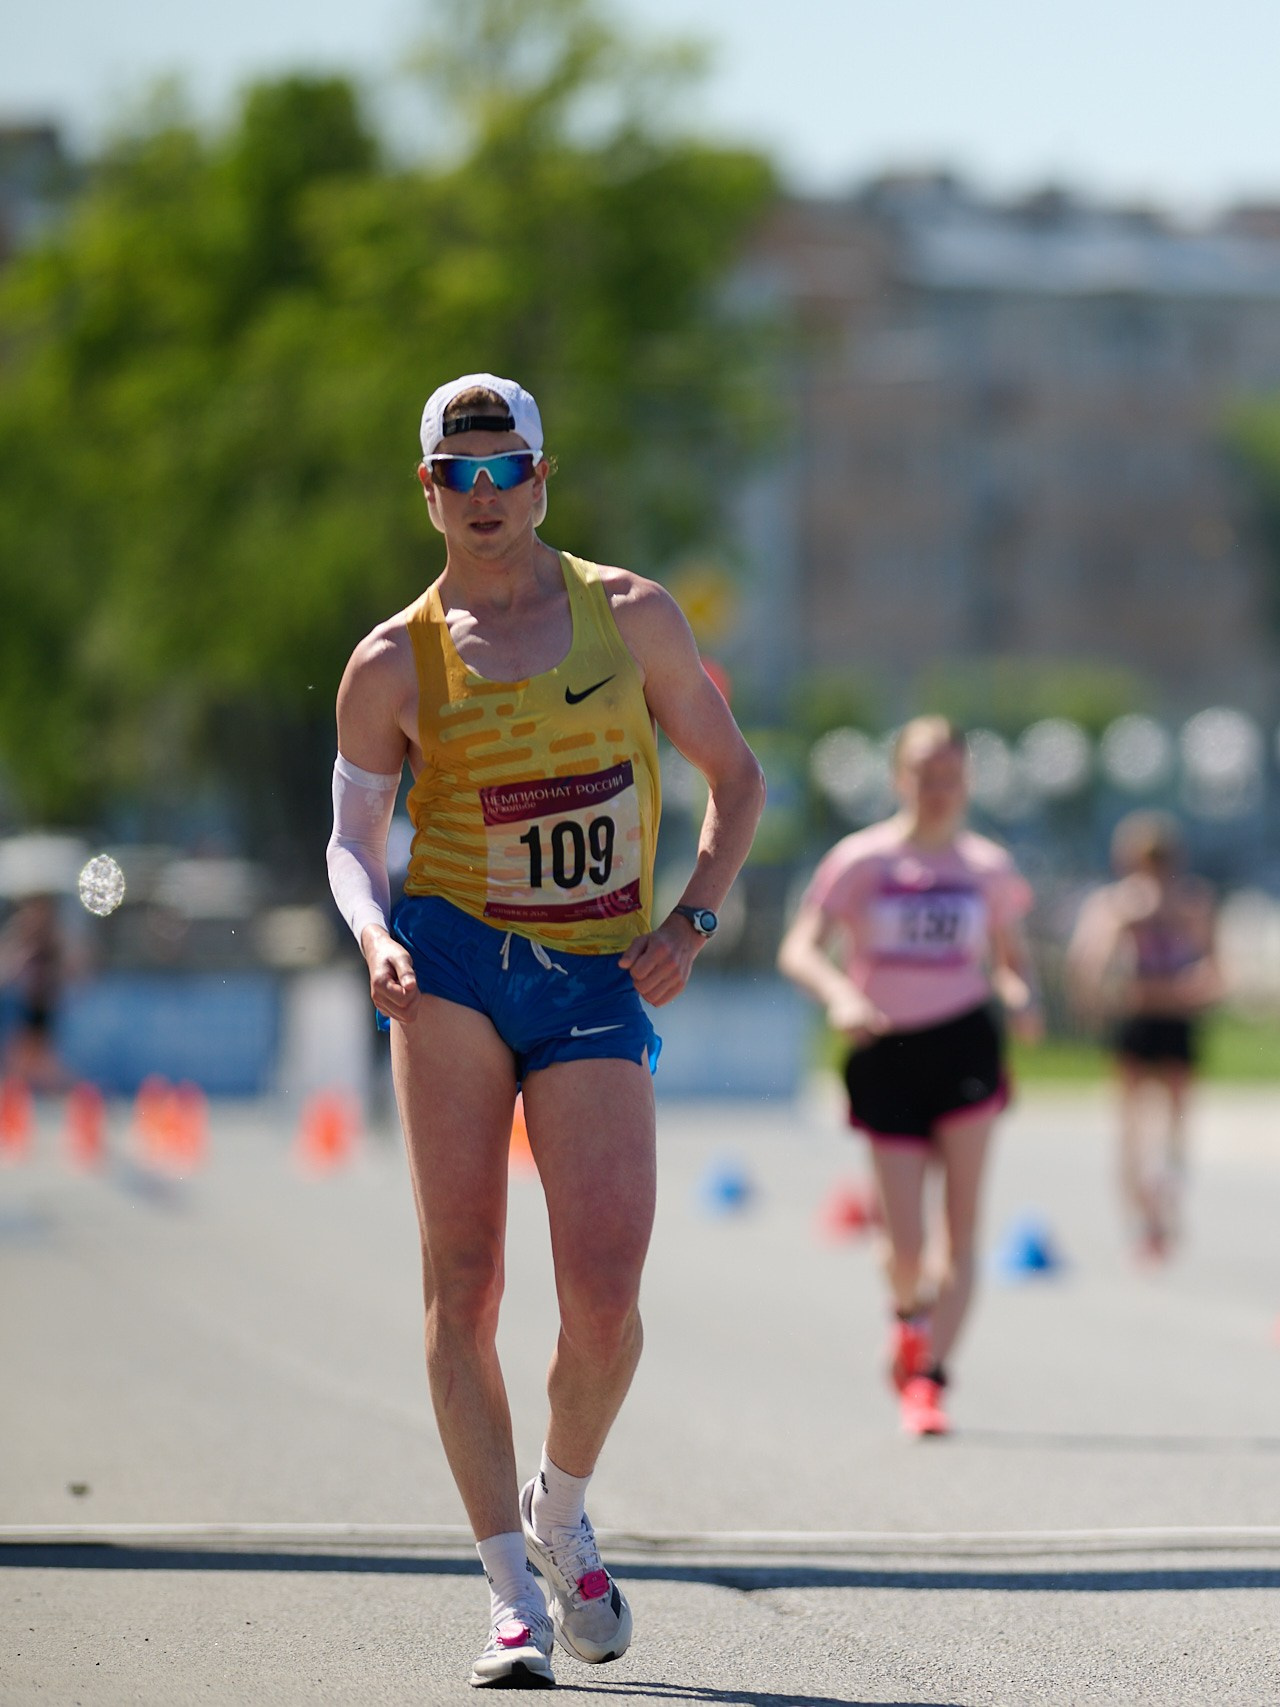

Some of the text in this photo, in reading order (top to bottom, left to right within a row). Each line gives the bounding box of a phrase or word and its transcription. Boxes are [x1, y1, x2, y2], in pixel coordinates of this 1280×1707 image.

[484, 774, 623, 807] ЧЕМПИОНАТ РОССИИ
[520, 816, 616, 889] 109
